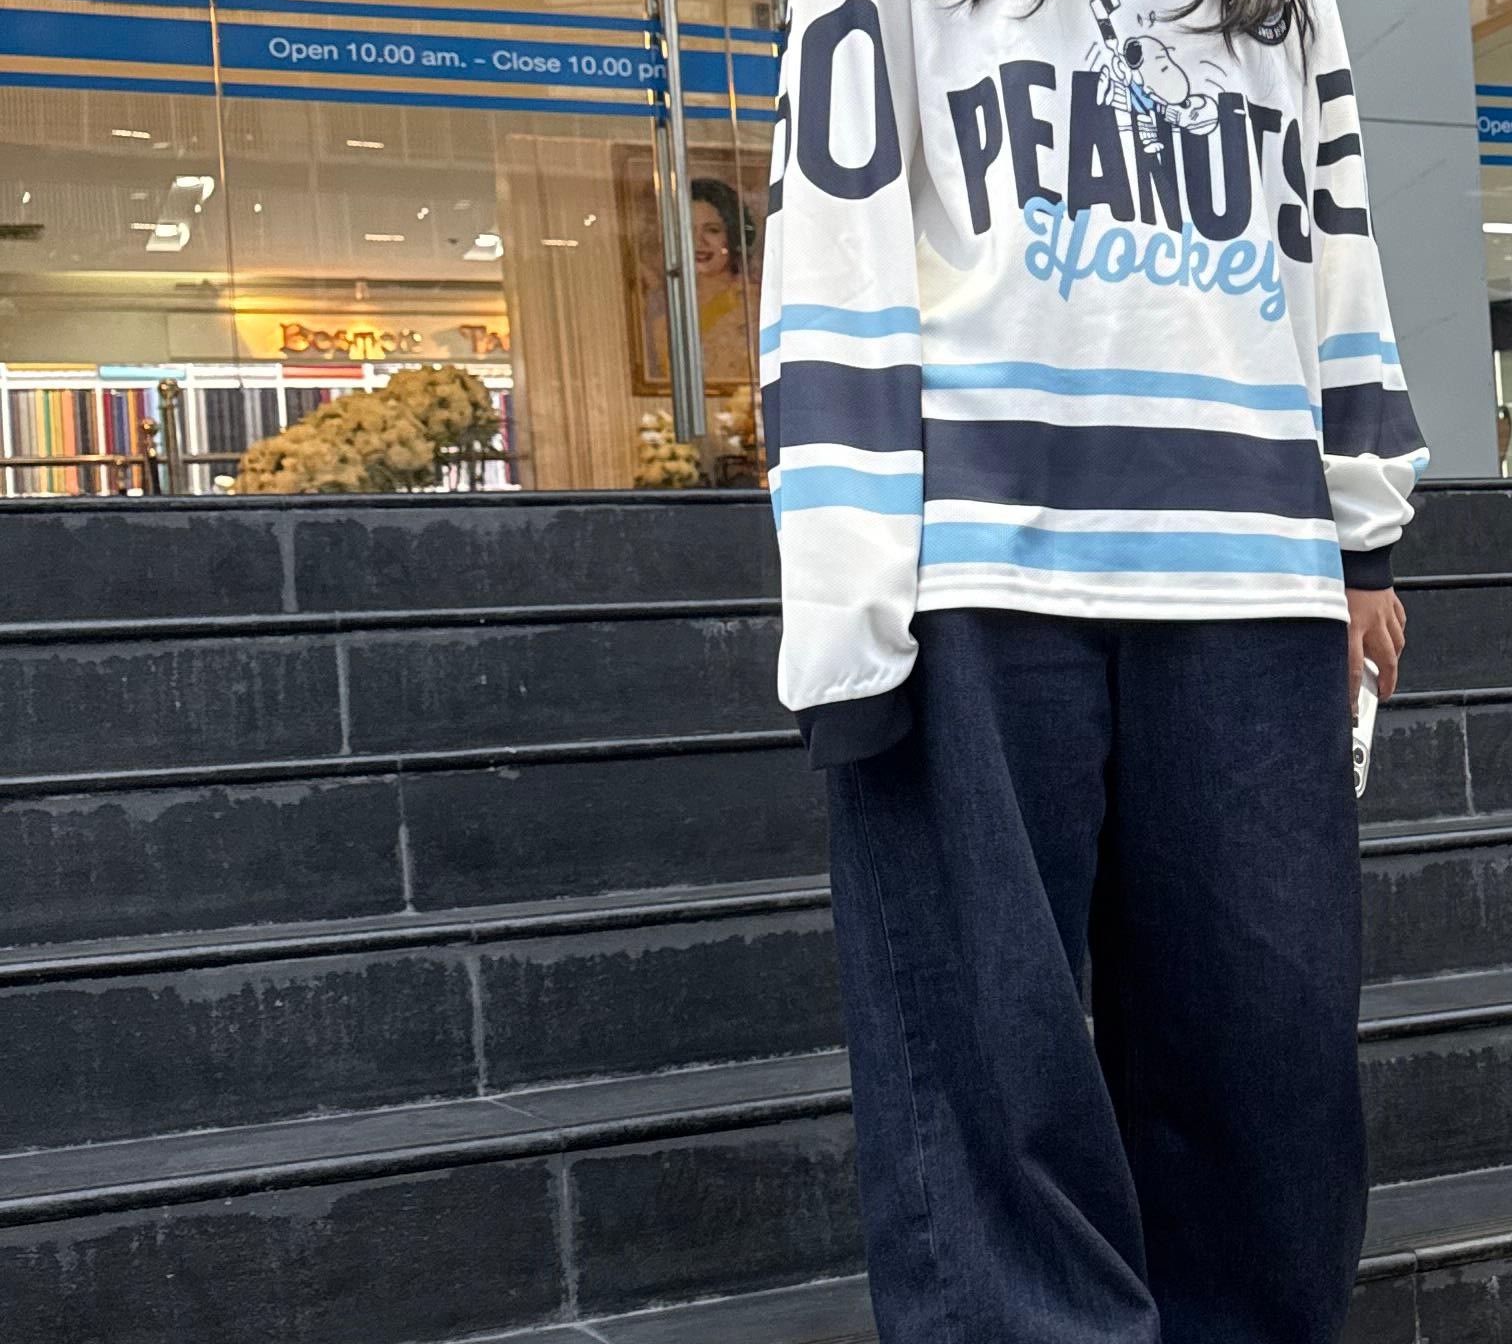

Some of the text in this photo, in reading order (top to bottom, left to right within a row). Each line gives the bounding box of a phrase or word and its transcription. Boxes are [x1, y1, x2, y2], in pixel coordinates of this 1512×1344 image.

[268, 37, 338, 63] Open
[346, 42, 415, 65] 10.00
[421, 50, 467, 68] am.
[492, 50, 561, 73] Close
[568, 56, 632, 77] 10.00
[946, 59, 1314, 264] PEANUTS
[1023, 196, 1287, 322] Hockey
